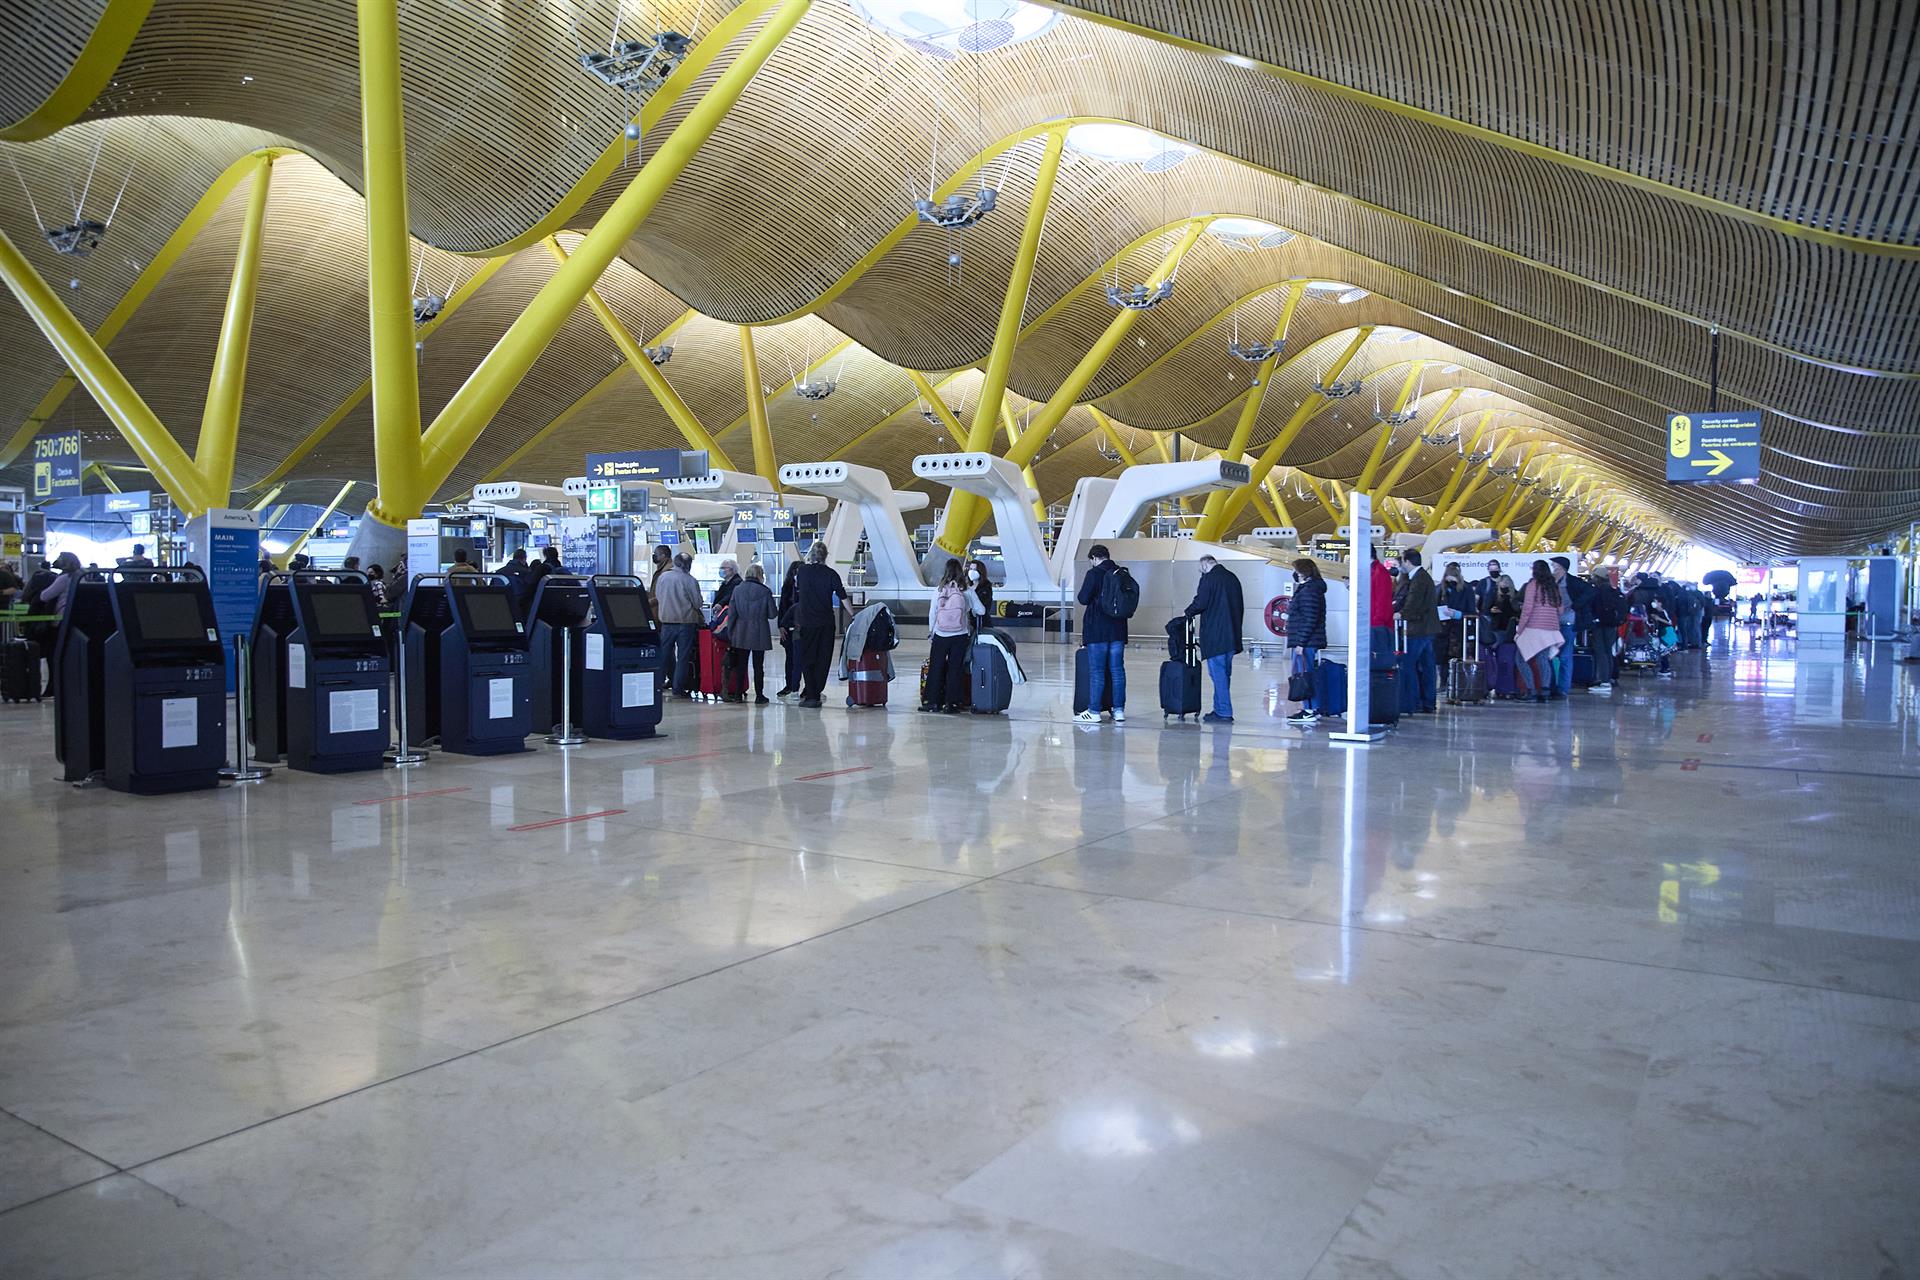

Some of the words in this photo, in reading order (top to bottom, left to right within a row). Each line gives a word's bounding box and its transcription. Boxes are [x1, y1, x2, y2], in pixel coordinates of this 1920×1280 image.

[660, 514, 675, 523] 764
[737, 511, 753, 521] 765
[773, 509, 790, 520] 766
[565, 549, 597, 558] cancelado
